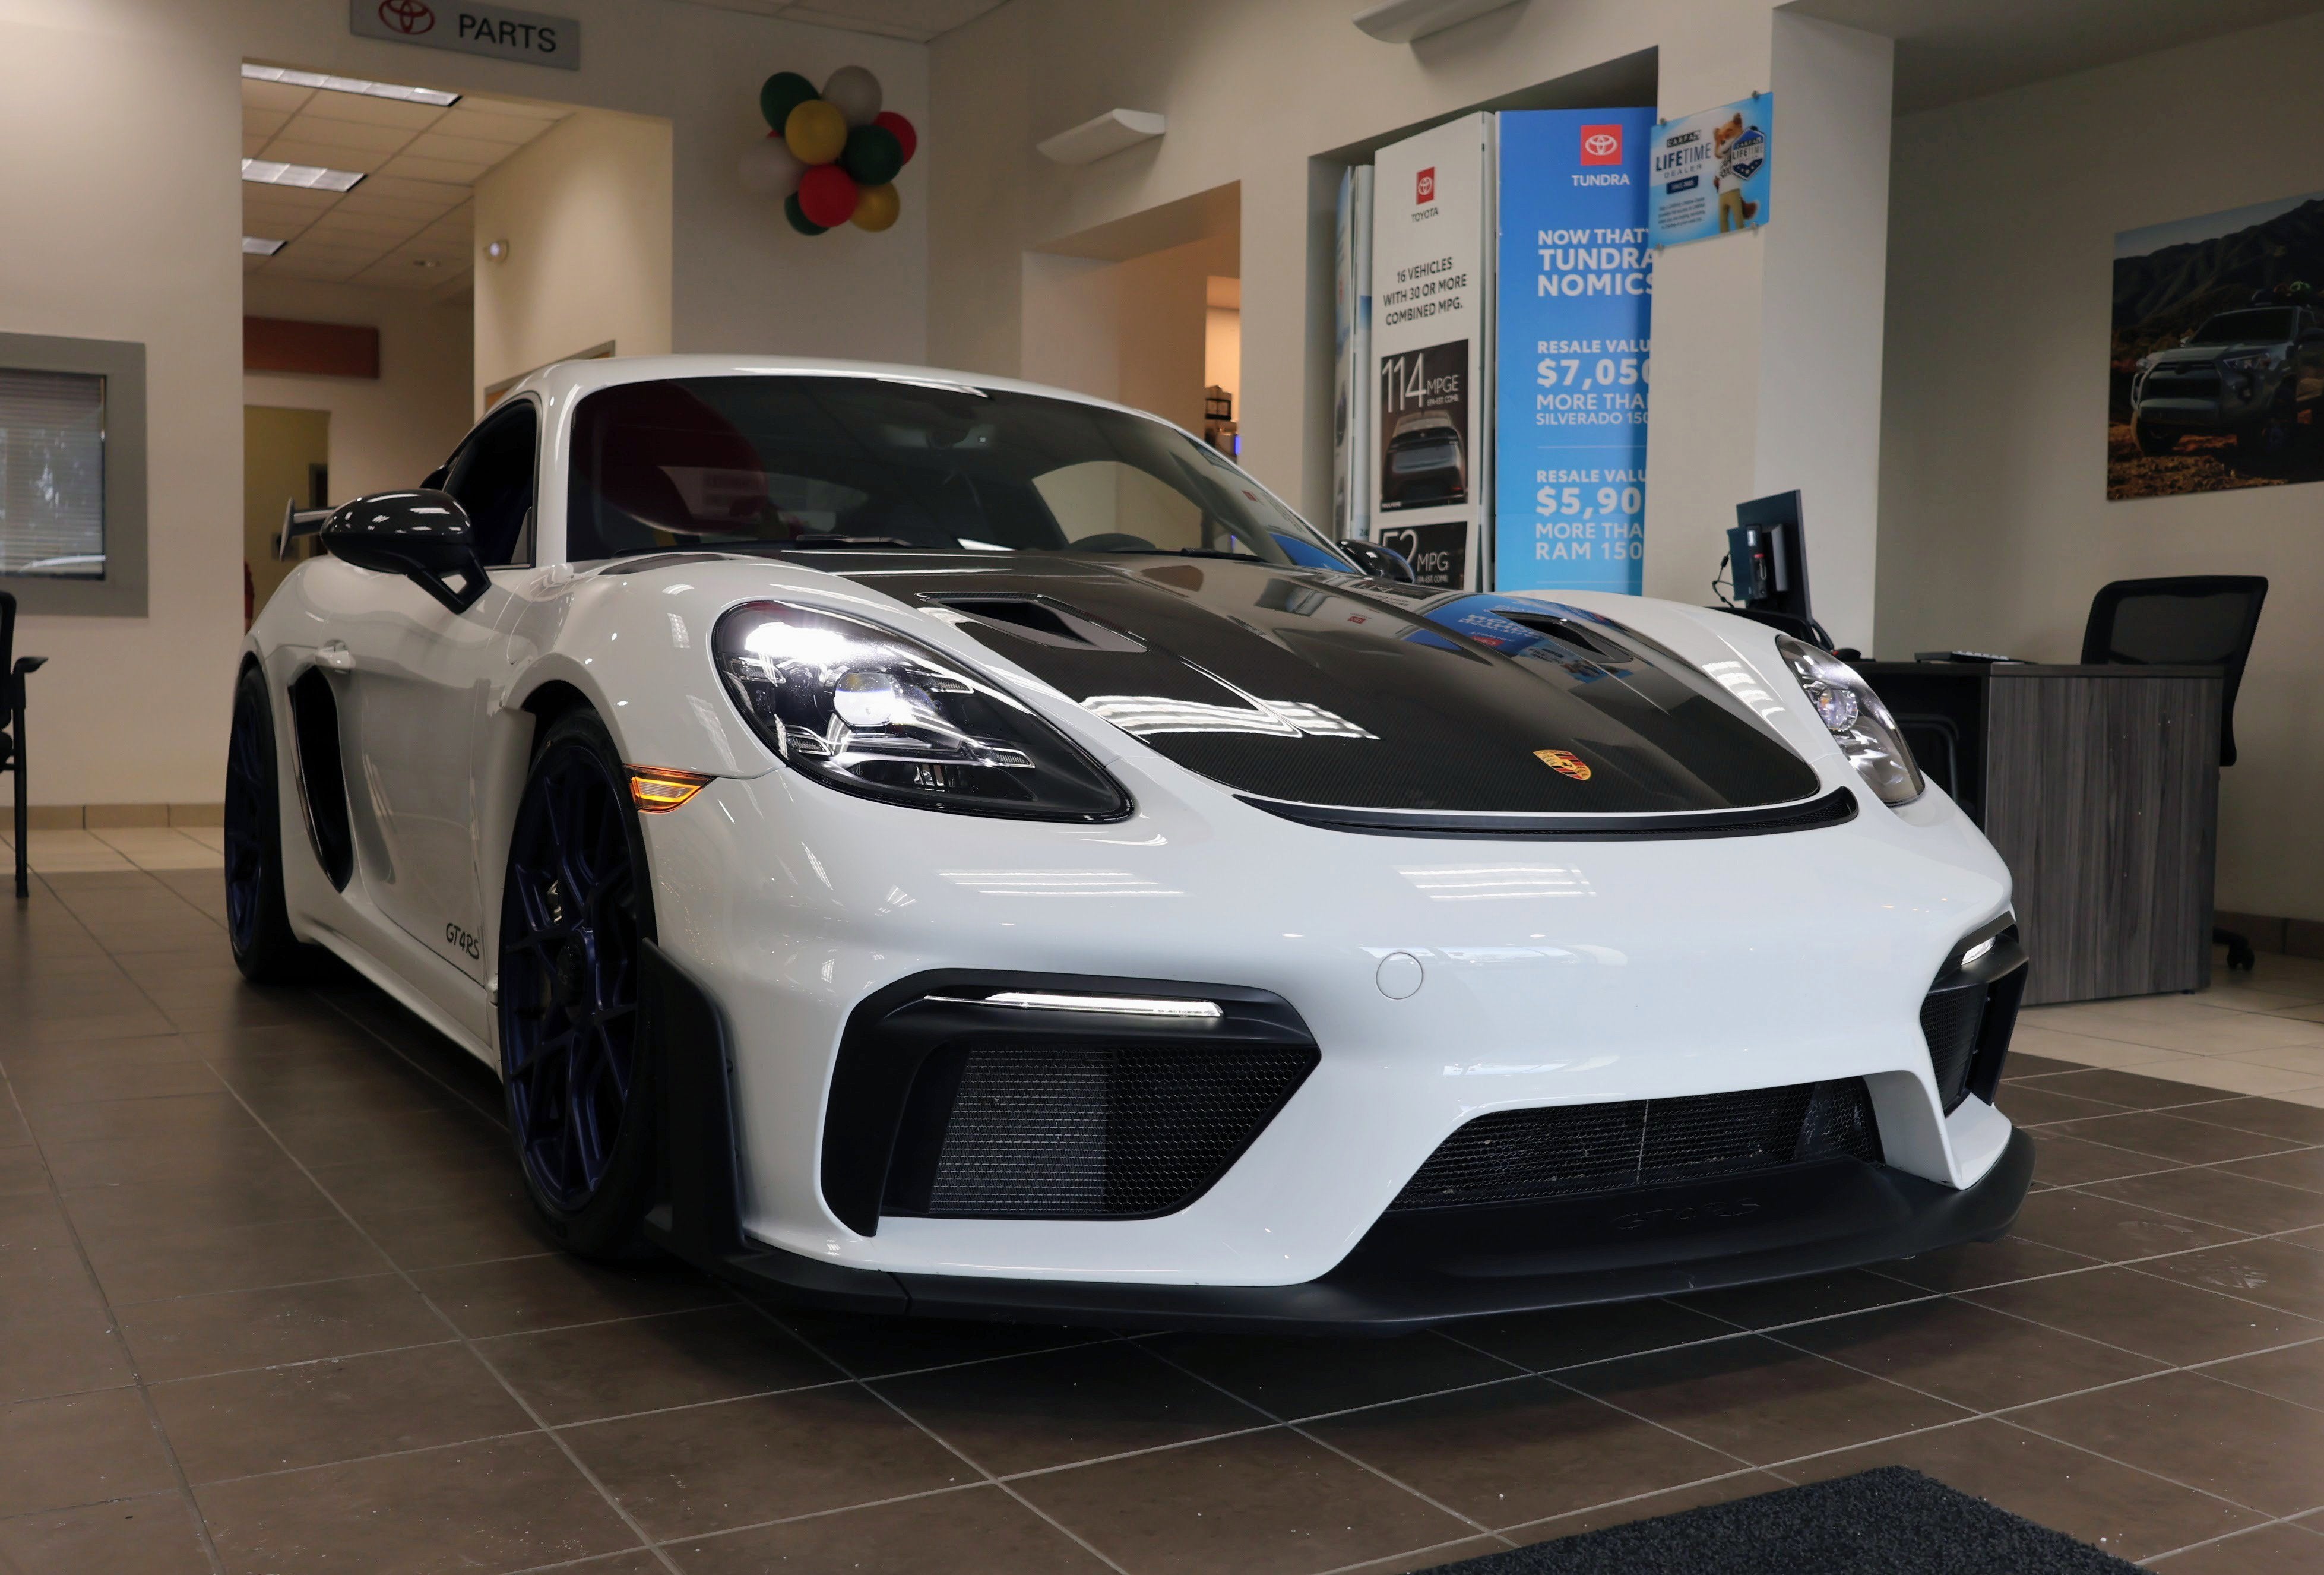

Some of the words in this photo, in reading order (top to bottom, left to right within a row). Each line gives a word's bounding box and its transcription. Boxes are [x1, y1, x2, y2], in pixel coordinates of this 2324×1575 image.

[458, 14, 556, 53] PARTS
[1656, 142, 1711, 172] LIFETIME
[1572, 174, 1630, 186] TUNDRA
[1664, 163, 1702, 178] DEALER
[1411, 207, 1438, 223] TOYOTA
[1538, 229, 1590, 245] NOW
[1538, 247, 1653, 271] TUNDRA
[1397, 270, 1406, 283] 16
[1408, 257, 1452, 280] VEHICLES
[1383, 289, 1407, 307] WITH
[1409, 286, 1420, 300] 30
[1422, 282, 1436, 296] OR
[1438, 273, 1467, 293] MORE
[1386, 303, 1436, 325] COMBINED
[1438, 296, 1463, 313] MPG.
[1537, 340, 1601, 353] RESALE
[1606, 339, 1650, 353] VALU
[1382, 352, 1427, 413] 114
[1427, 374, 1459, 396] MPGE
[1537, 394, 1597, 410] MORE
[1603, 393, 1648, 409] THA
[1535, 412, 1622, 425] SILVERADO
[1537, 470, 1600, 483] RESALE
[1535, 523, 1596, 539] MORE
[1535, 542, 1591, 560] RAM
[1601, 541, 1643, 560] 150
[1417, 551, 1449, 571] MPG
[446, 922, 480, 960] GT4RS
